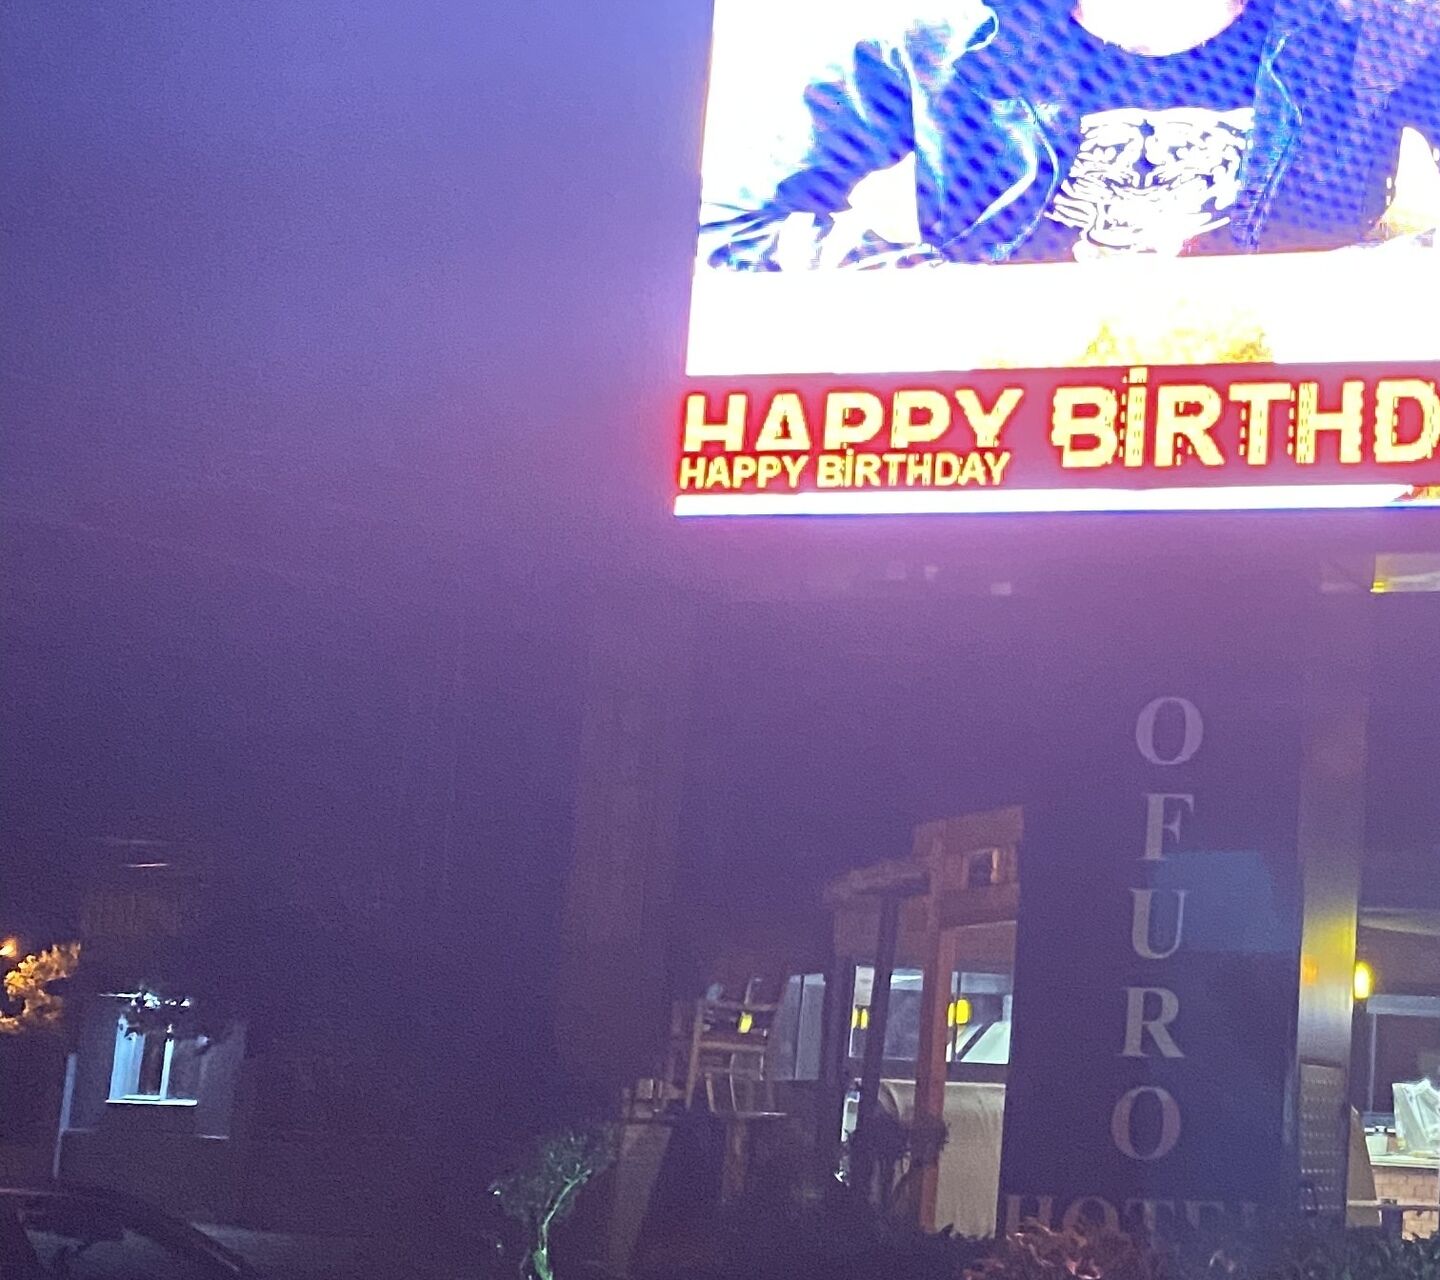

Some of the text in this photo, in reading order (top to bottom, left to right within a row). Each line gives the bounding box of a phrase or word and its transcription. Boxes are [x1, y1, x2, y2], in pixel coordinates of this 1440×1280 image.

[683, 388, 1024, 452] HAPPY
[679, 453, 808, 489] HAPPY
[1111, 696, 1204, 1161] OFURO
